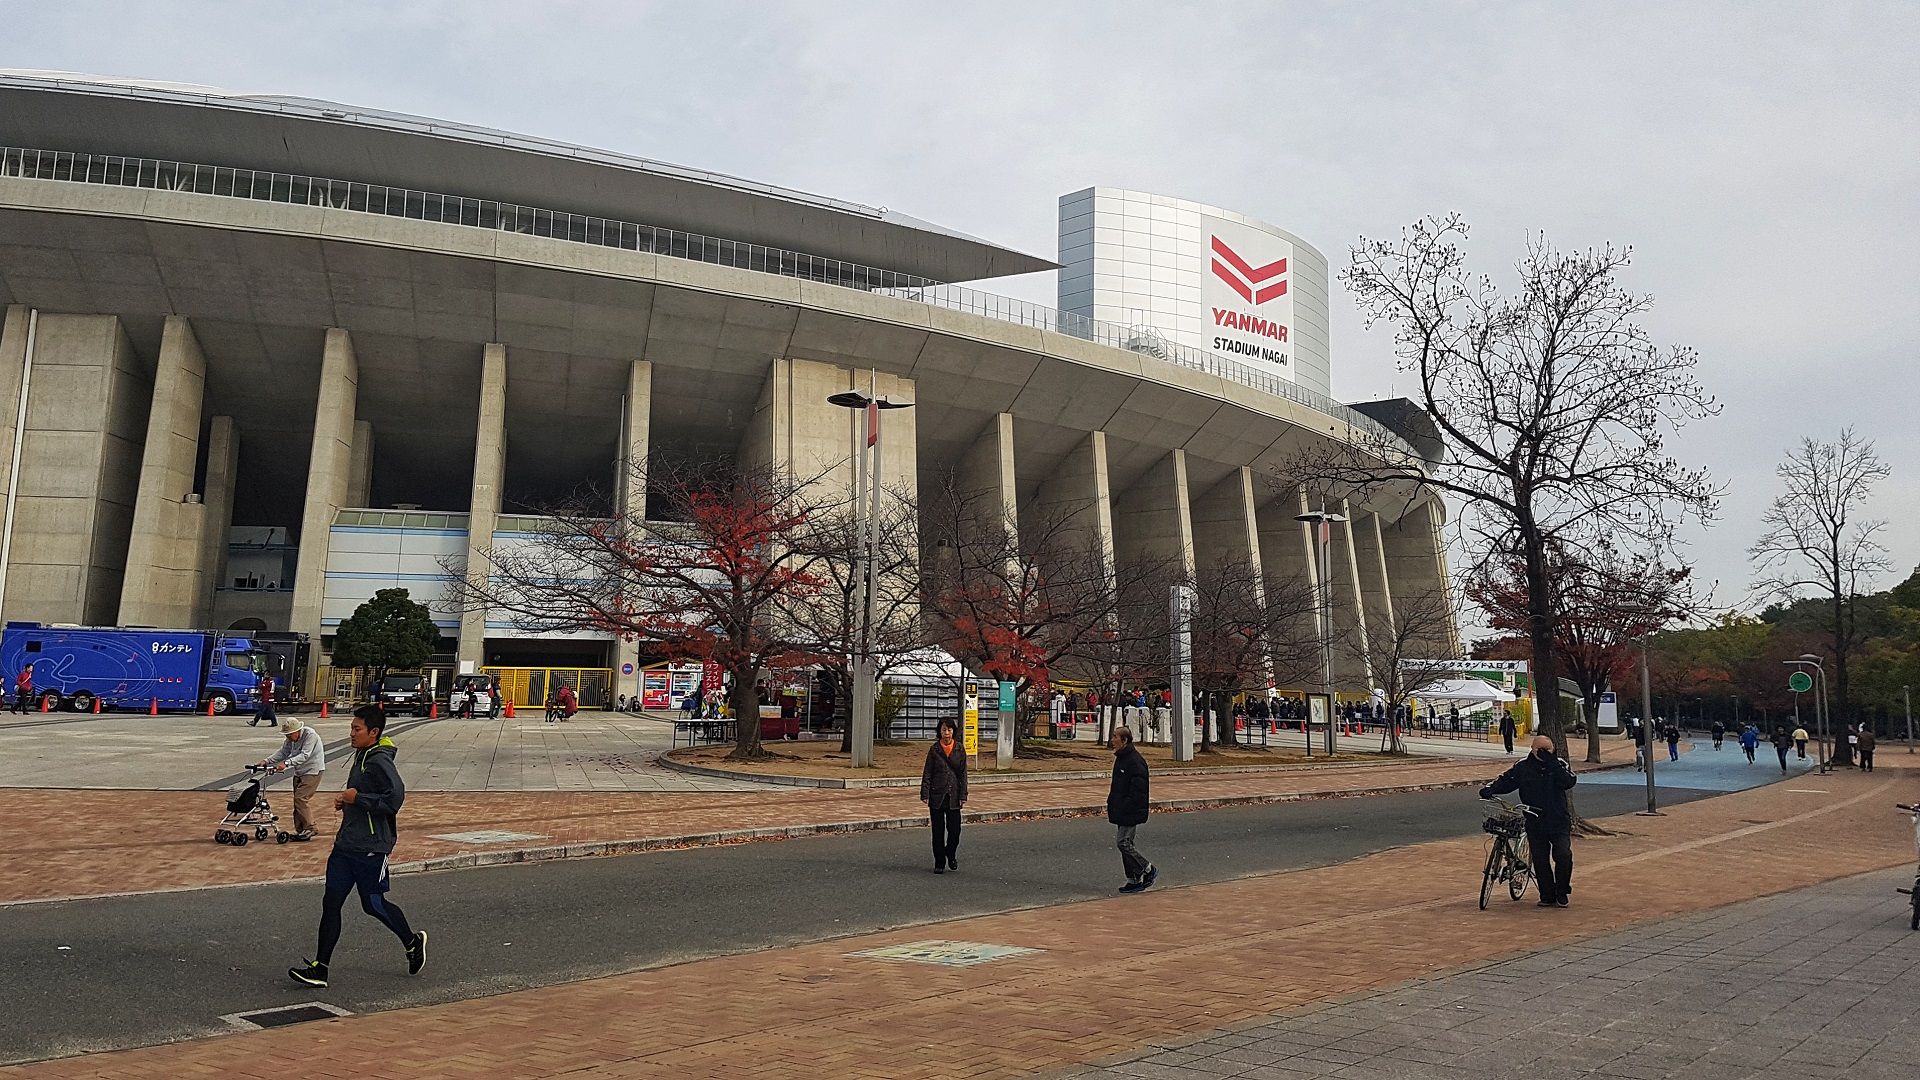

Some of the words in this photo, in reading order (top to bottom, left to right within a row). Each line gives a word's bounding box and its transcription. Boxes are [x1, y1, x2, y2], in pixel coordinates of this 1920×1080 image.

[1212, 307, 1288, 343] YANMAR
[1213, 337, 1260, 358] STADIUM
[1262, 347, 1288, 366] NAGAI
